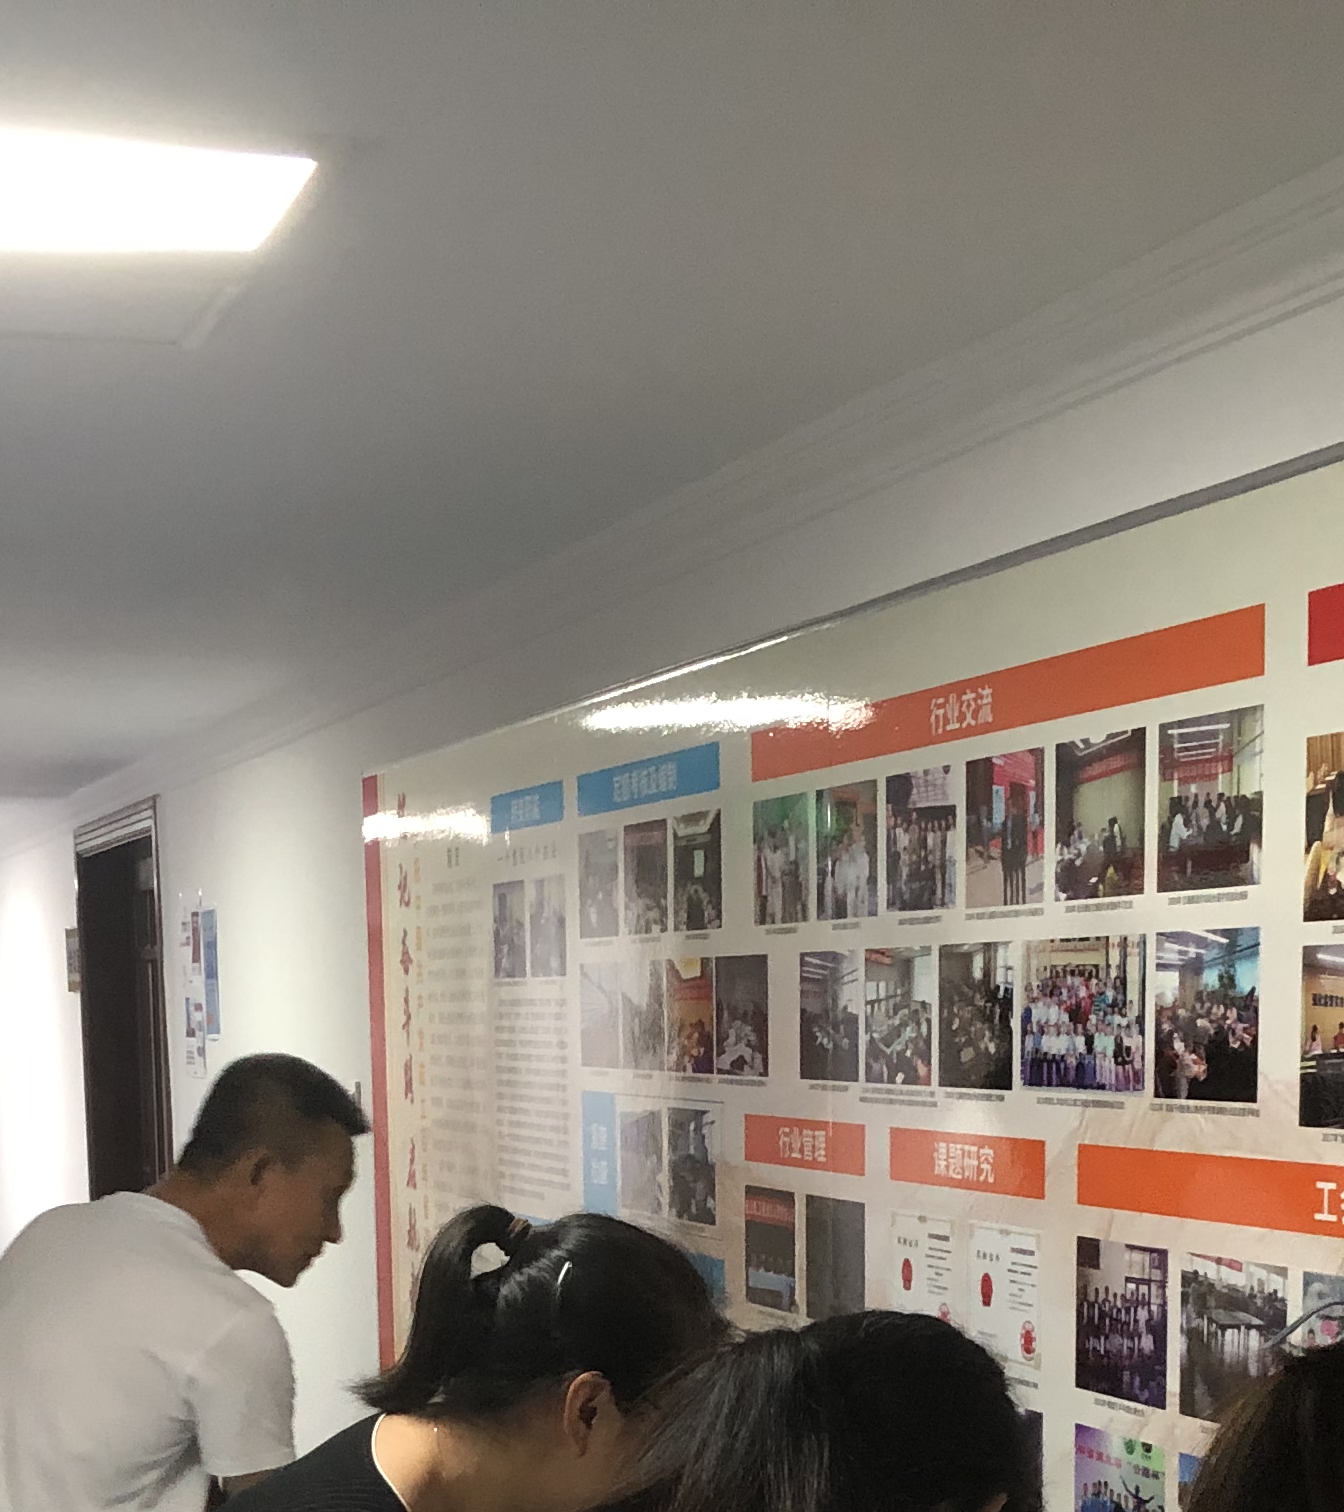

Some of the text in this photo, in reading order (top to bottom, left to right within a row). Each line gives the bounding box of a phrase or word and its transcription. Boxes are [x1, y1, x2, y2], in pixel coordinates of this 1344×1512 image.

[929, 685, 994, 736] 行业交流
[778, 1126, 827, 1162] 行业管理
[932, 1142, 995, 1183] 课题研究
